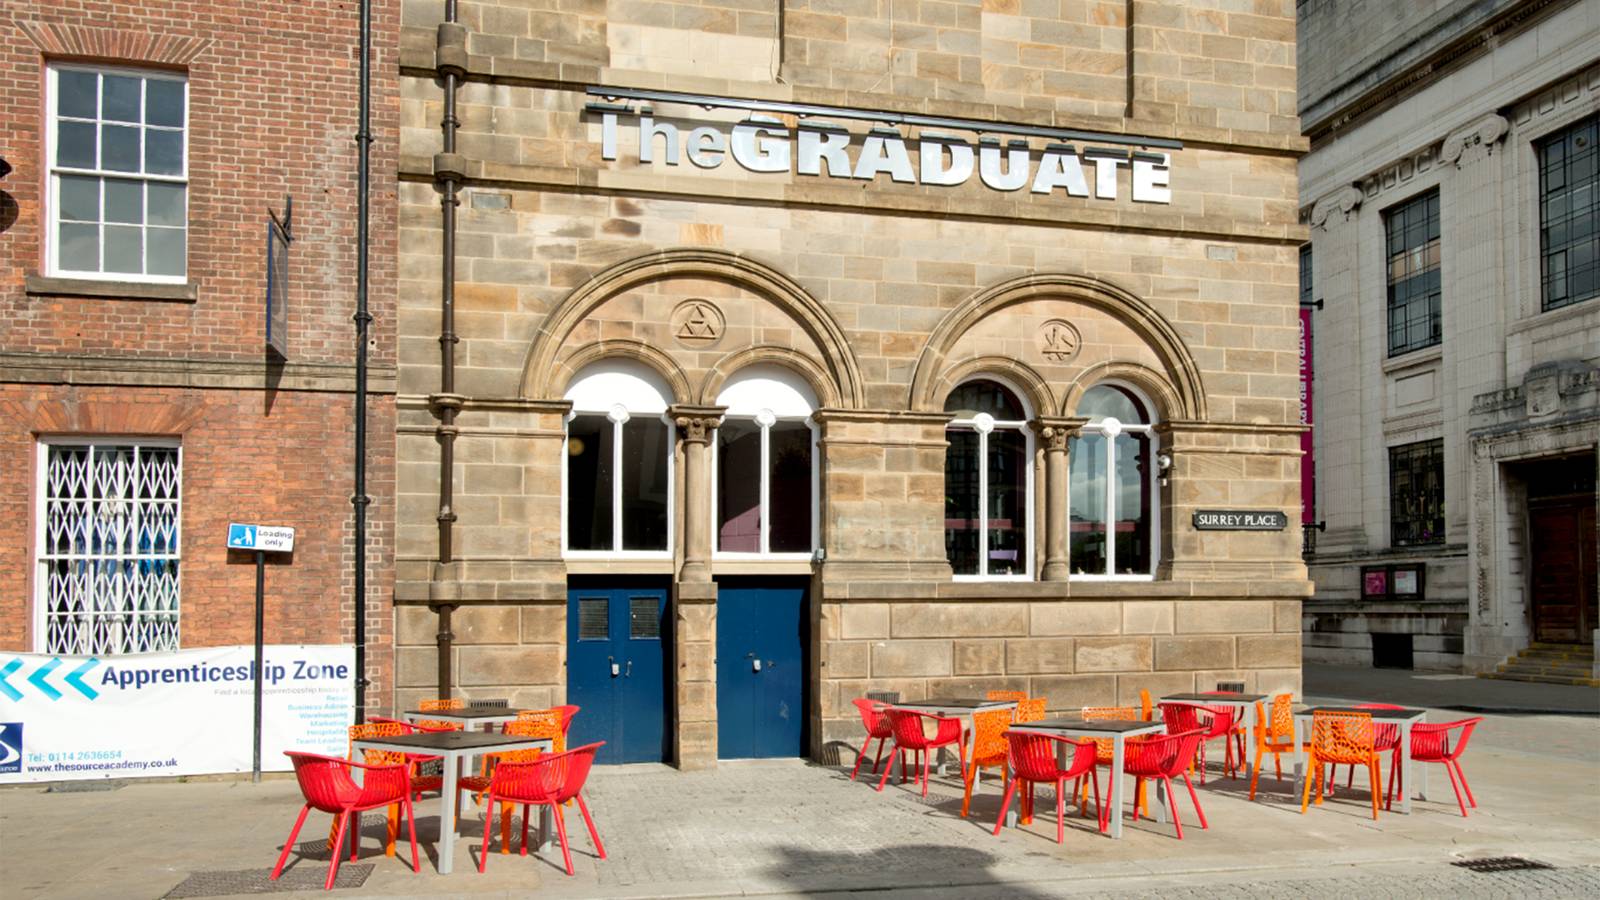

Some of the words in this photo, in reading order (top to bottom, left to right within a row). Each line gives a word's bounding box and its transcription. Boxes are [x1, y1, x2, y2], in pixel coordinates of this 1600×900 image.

[1199, 514, 1242, 525] SURREY
[1244, 514, 1277, 526] PLACE
[258, 530, 293, 539] Loading
[265, 539, 283, 547] only
[293, 660, 348, 680] Zone
[28, 754, 45, 762] Tel:
[48, 752, 74, 761] 0114
[27, 758, 178, 773] www.thesourceacademy.co.uk
